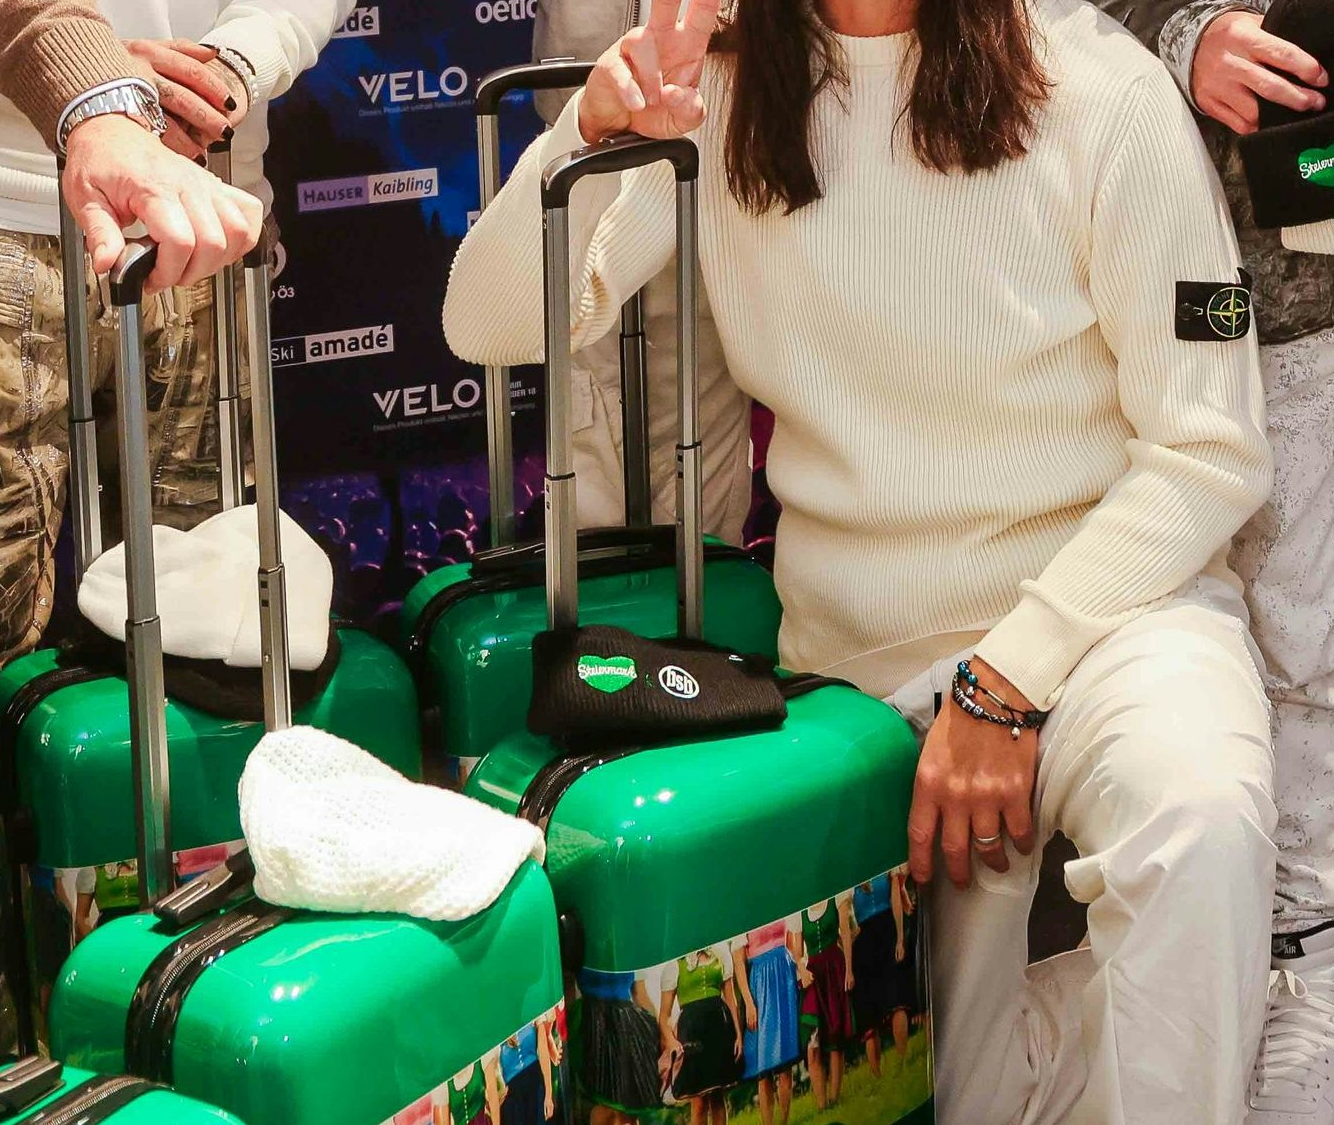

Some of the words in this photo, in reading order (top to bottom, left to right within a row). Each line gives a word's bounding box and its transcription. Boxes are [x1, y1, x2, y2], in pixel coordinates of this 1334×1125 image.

[359, 66, 467, 104] VELO
[303, 187, 364, 204] HAUSER
[373, 177, 434, 196] Kaibling
[277, 285, 295, 298] Ö3
[271, 346, 294, 362] Ski
[309, 324, 389, 357] amadé
[373, 379, 480, 419] VELO
